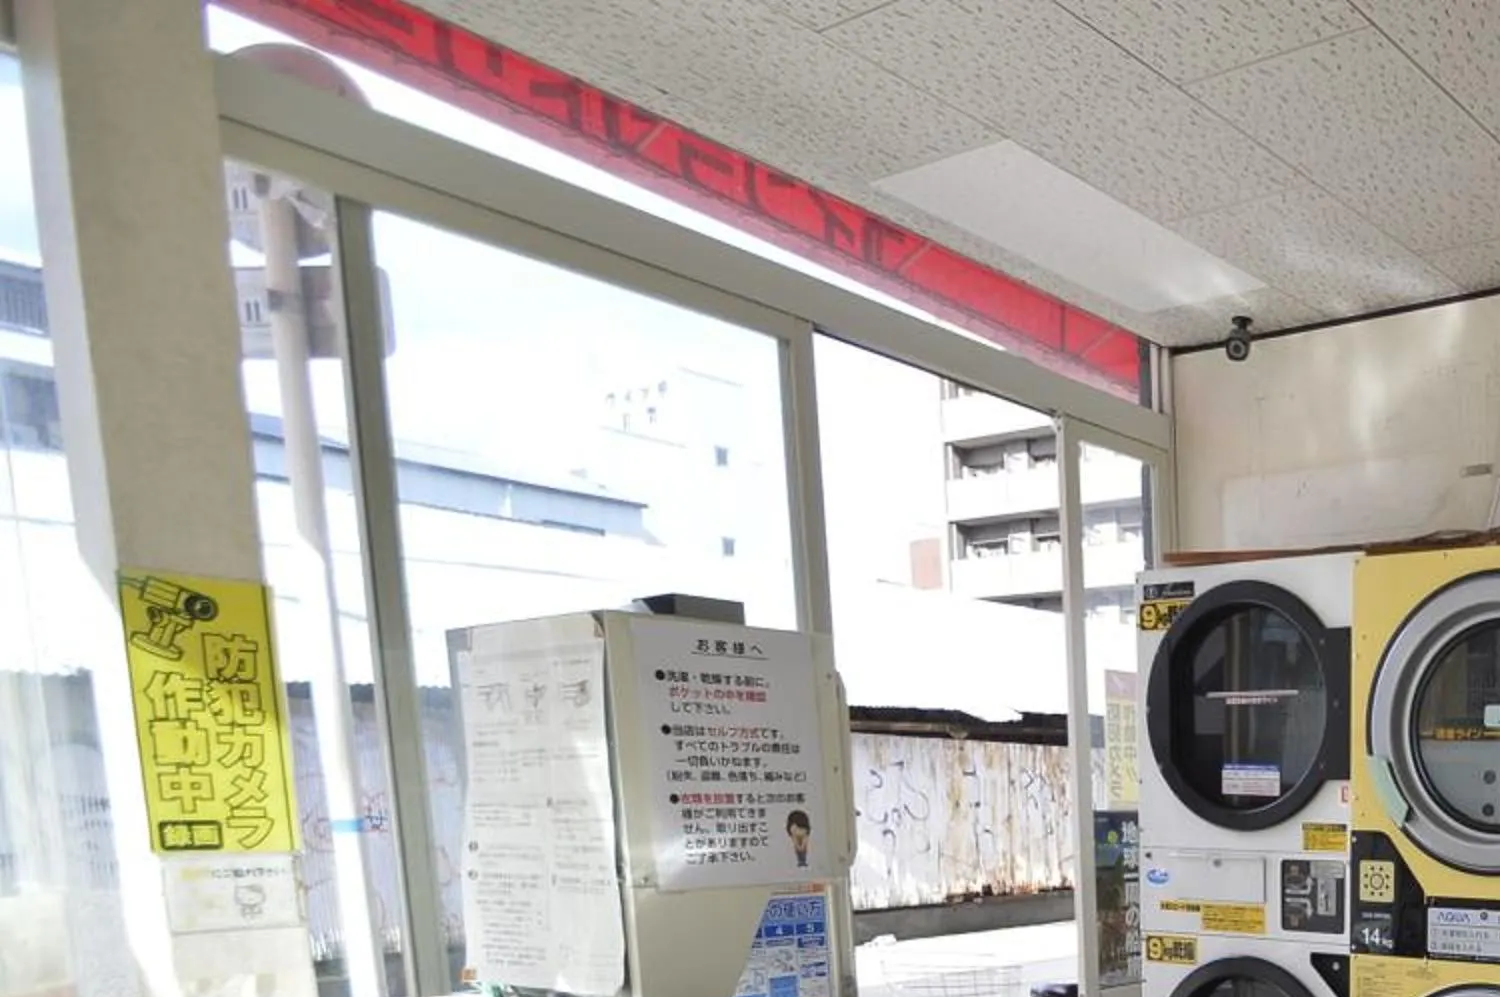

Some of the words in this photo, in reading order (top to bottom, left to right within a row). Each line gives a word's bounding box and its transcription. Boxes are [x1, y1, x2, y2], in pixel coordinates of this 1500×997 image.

[697, 639, 763, 655] お客様へ
[667, 670, 770, 687] 洗濯・乾燥する前に、
[669, 686, 768, 703] ポケットの中を確認
[671, 702, 732, 716] して下さい。
[673, 725, 785, 740] 当店はセルフ方式です。
[144, 670, 216, 815] 作動中
[200, 631, 276, 851] 防犯カメラ
[684, 836, 769, 849] とがありますので
[686, 851, 757, 865] ご了承下さい。
